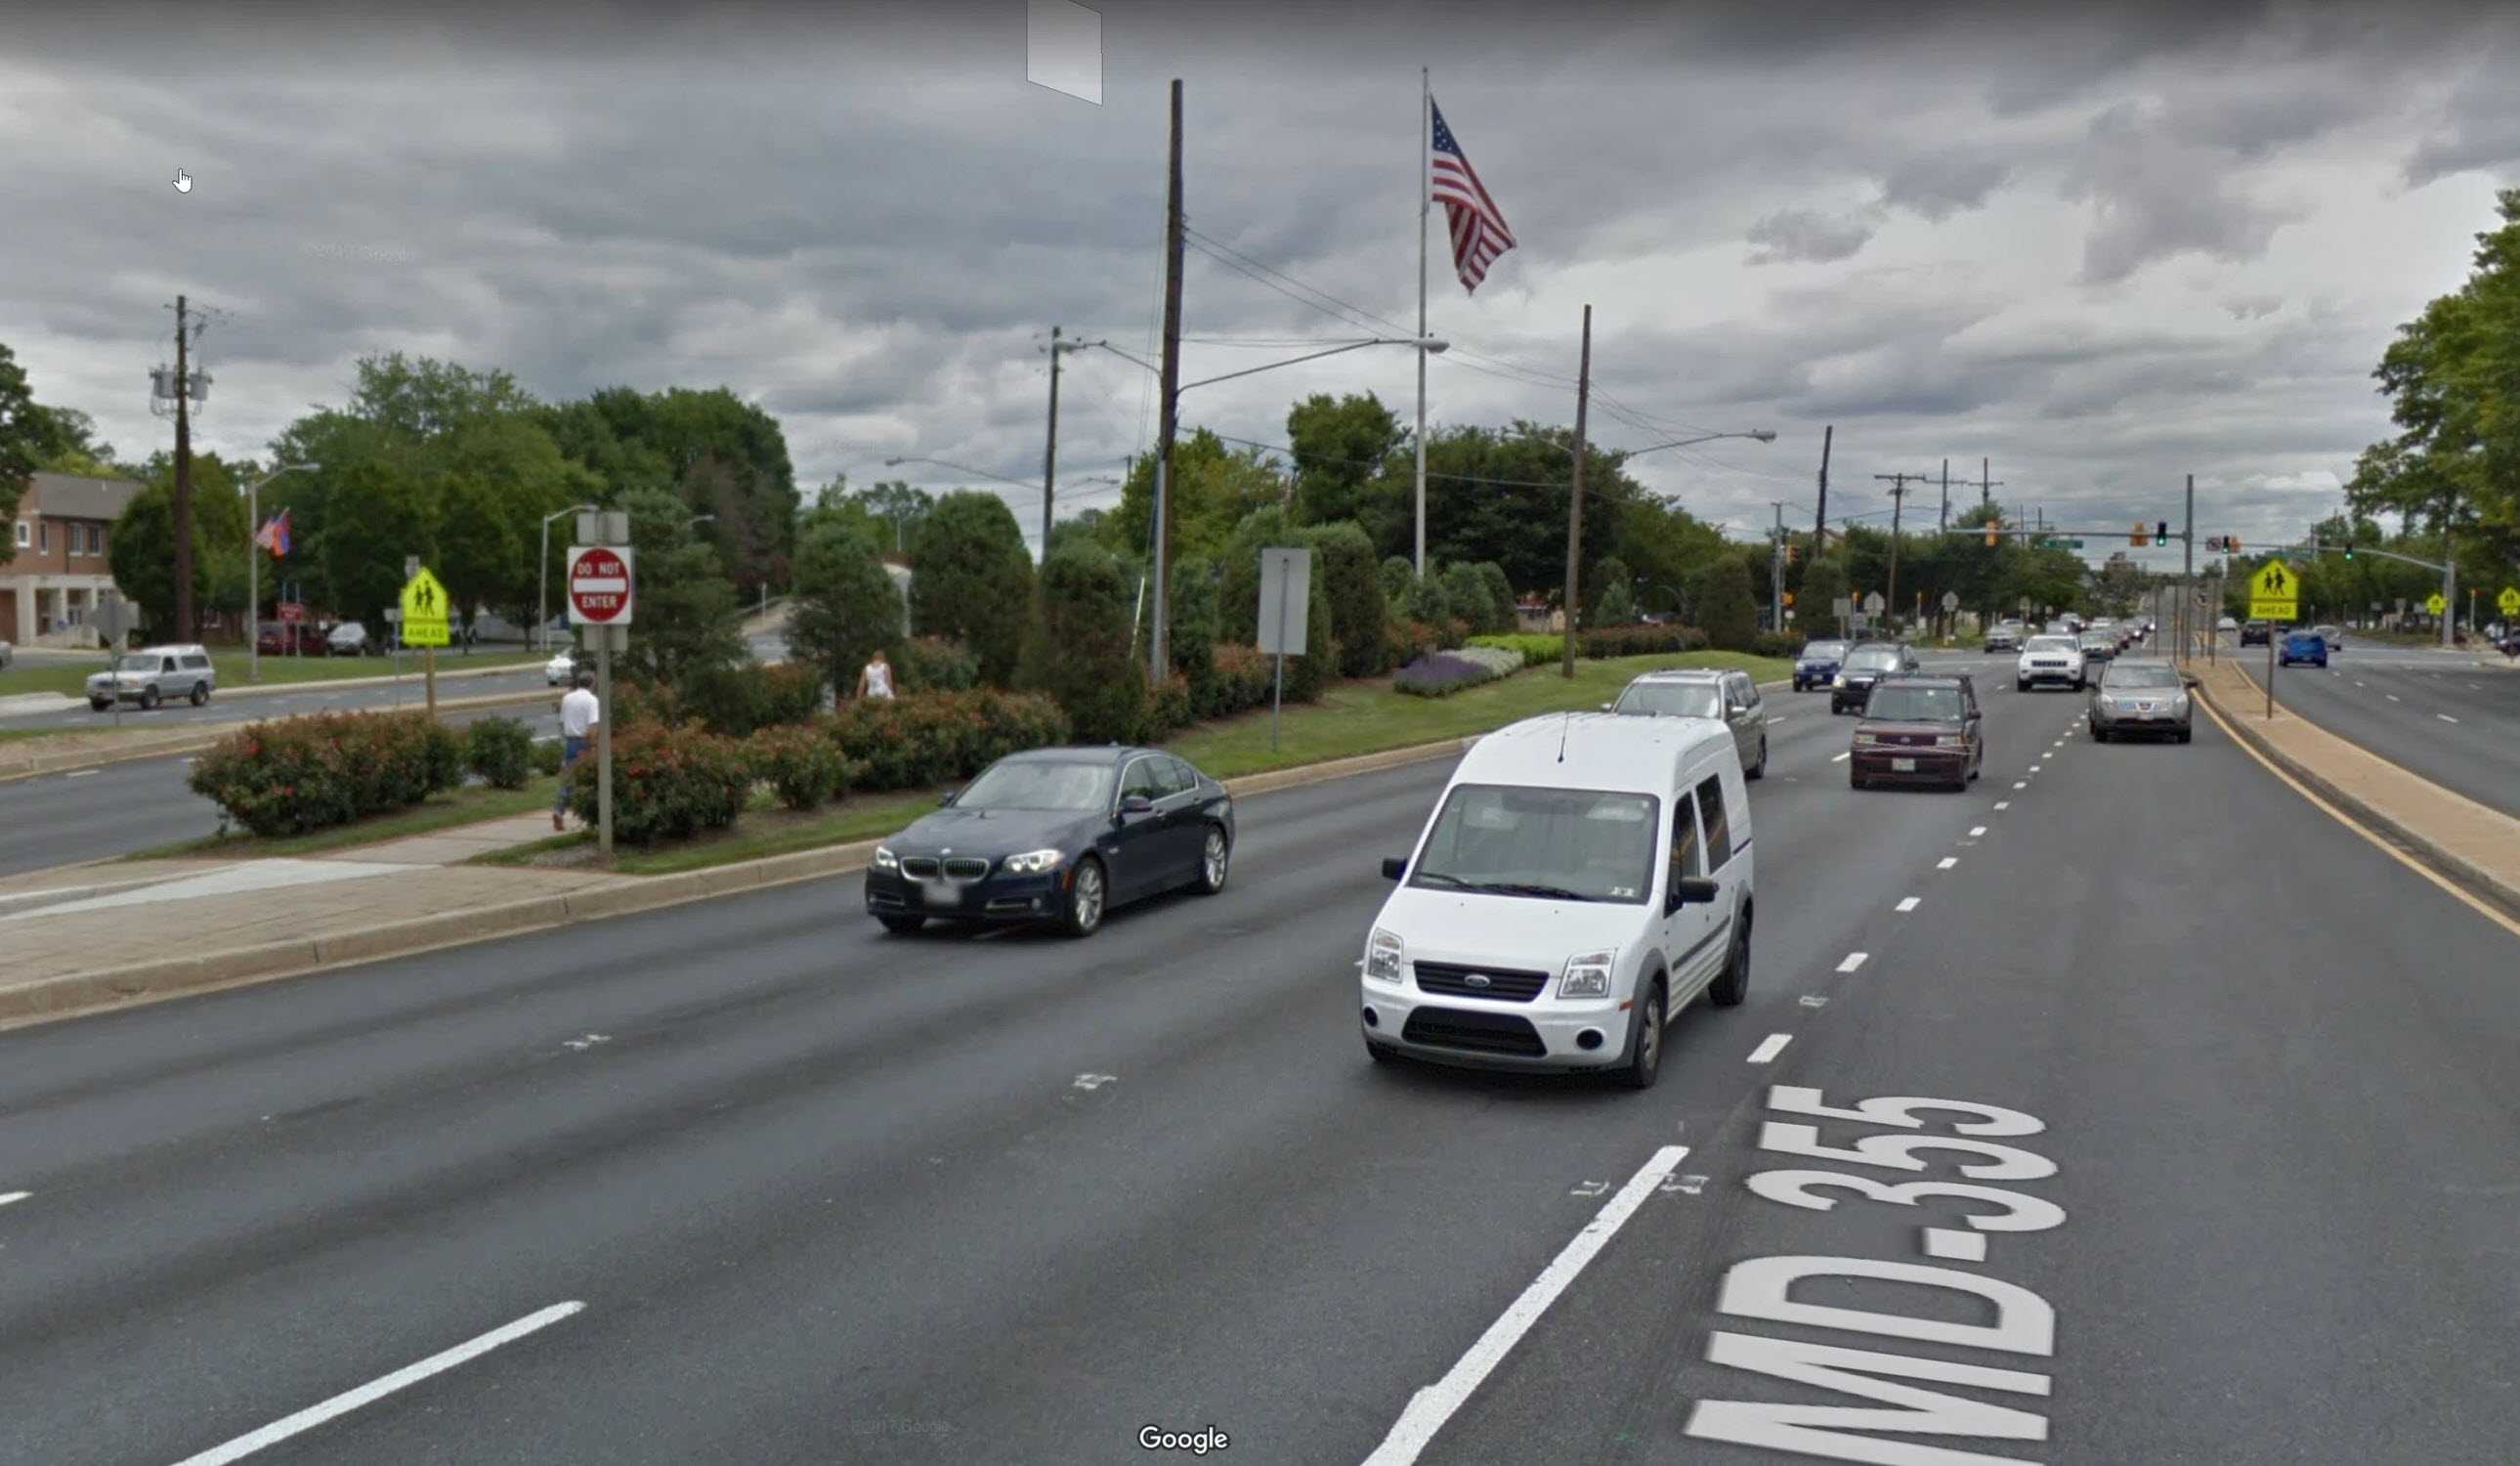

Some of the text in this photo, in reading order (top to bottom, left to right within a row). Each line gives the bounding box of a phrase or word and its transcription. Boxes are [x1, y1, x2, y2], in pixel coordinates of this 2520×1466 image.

[577, 562, 619, 575] DO NOT
[581, 595, 618, 609] ENTER
[2256, 606, 2292, 616] AHEAD
[408, 627, 445, 638] AHEAD
